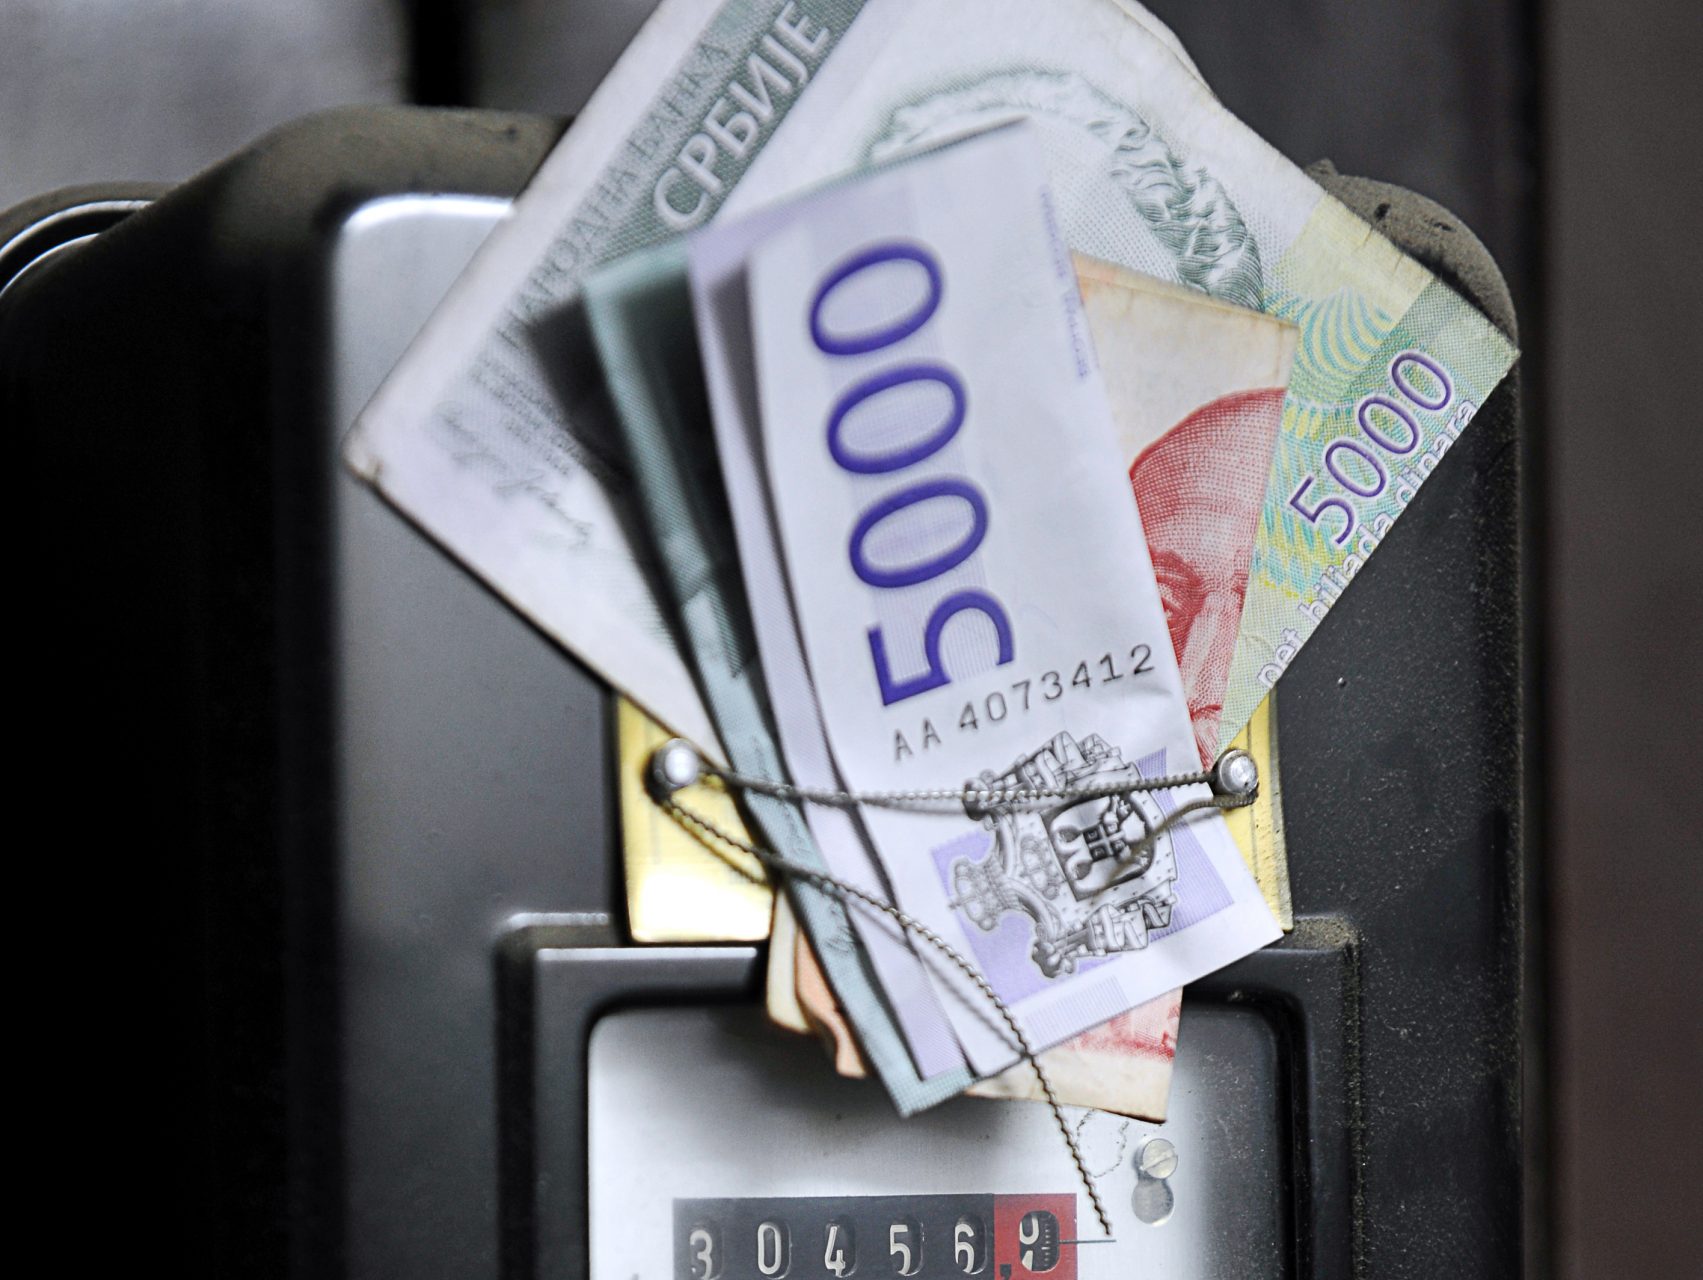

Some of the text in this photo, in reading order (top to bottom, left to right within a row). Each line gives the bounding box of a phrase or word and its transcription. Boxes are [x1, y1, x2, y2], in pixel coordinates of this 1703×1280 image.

[653, 2, 831, 229] СРБИЈЕ
[809, 238, 1015, 706] 5000
[1288, 350, 1453, 545] 5000
[893, 643, 1154, 761] AA 4073412
